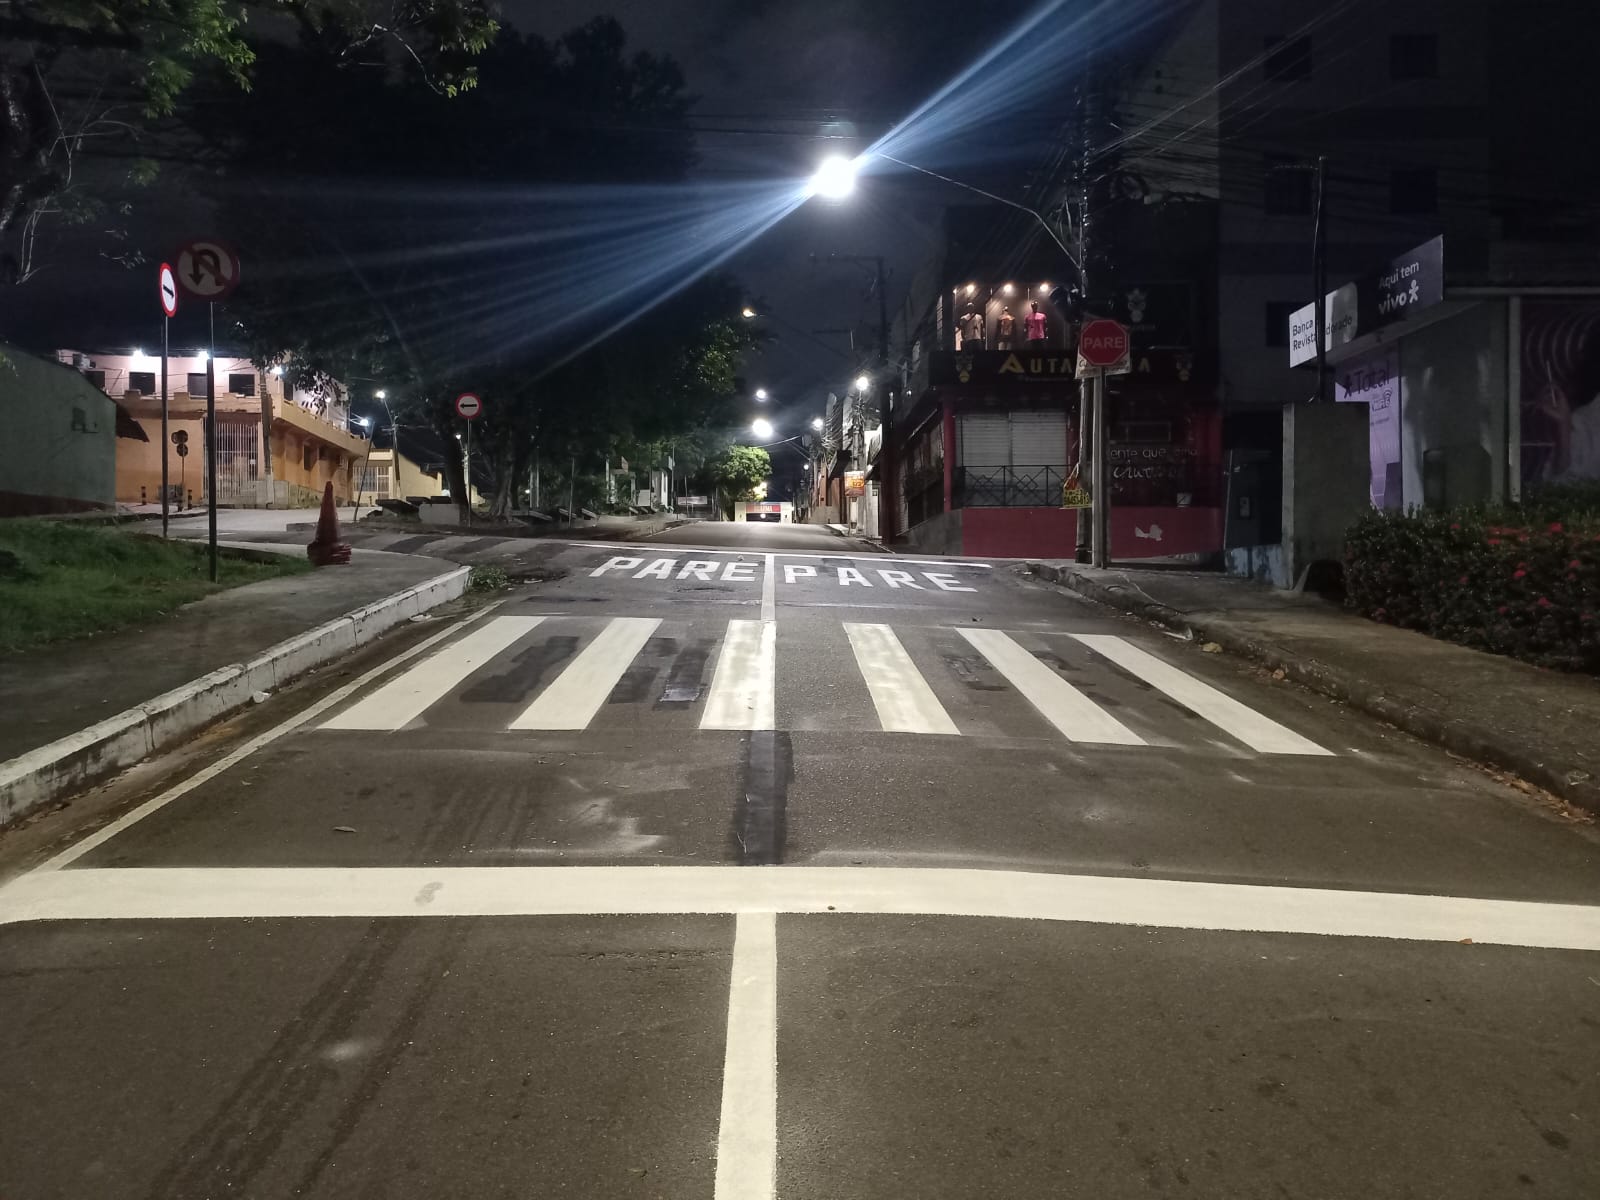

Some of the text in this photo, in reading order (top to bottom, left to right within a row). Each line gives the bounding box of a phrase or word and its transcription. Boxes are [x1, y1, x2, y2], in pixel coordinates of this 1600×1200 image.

[1378, 261, 1420, 290] Aqui tem
[1378, 291, 1407, 315] vivo
[1292, 319, 1314, 337] Banca
[1083, 336, 1125, 349] PARE
[1353, 360, 1390, 395] Total
[588, 556, 760, 583] PARE
[783, 564, 979, 593] PARE
